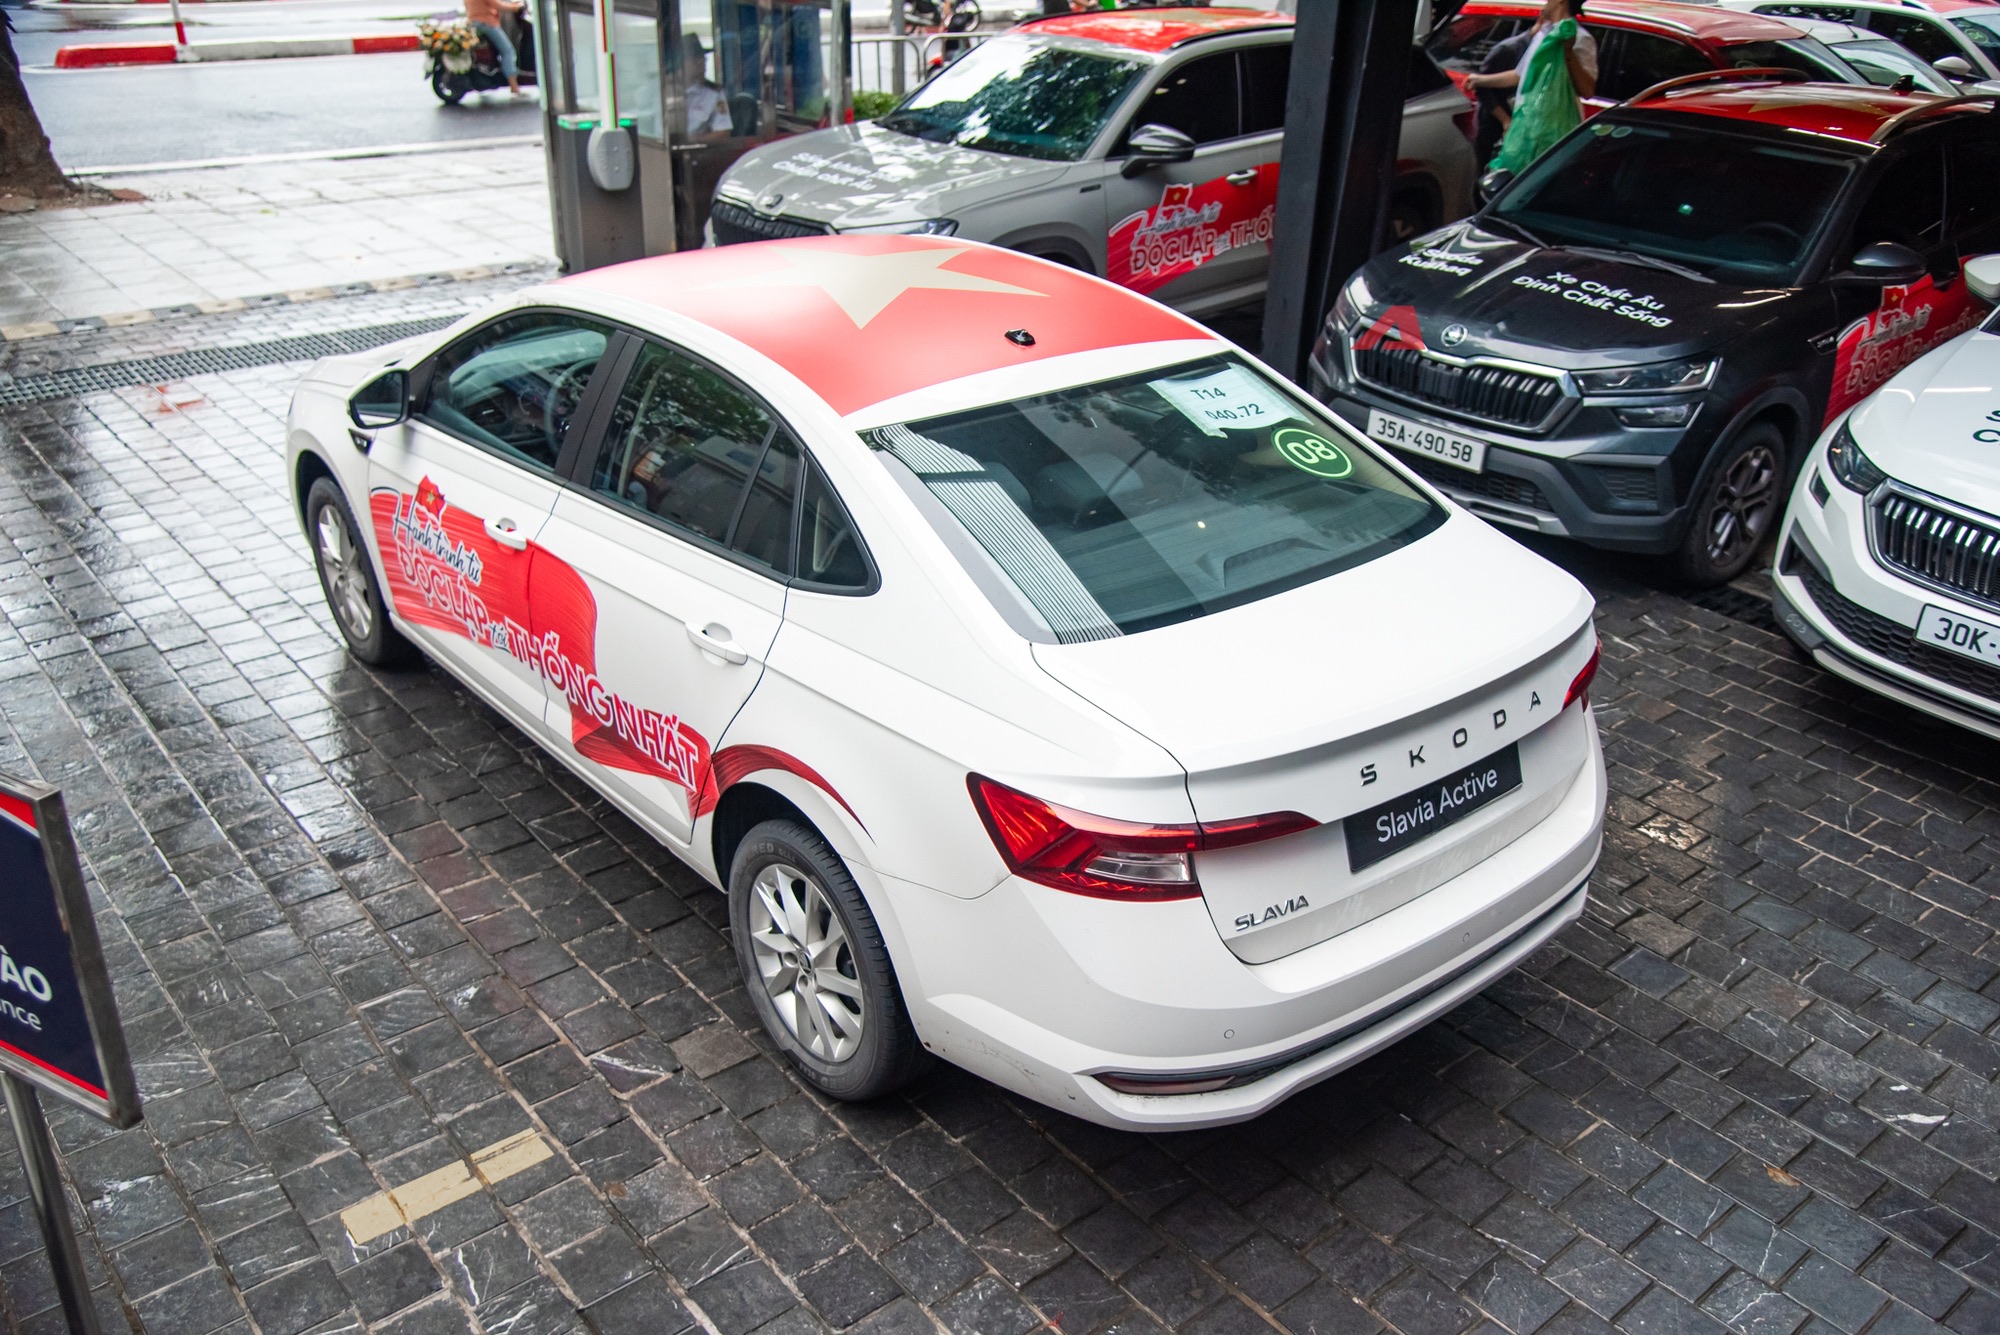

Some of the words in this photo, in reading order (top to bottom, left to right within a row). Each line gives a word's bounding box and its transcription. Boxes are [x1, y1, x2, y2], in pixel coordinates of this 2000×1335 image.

[1130, 233, 1181, 276] ĐỘC
[1179, 227, 1219, 266] LẬP
[1230, 205, 1276, 249] THỐ
[1511, 275, 1562, 294] Định
[1562, 289, 1616, 311] Chất
[1613, 304, 1674, 328] Sống
[1546, 271, 1579, 285] Xe
[1580, 280, 1634, 301] Chất
[1628, 295, 1666, 311] Âu
[1190, 387, 1226, 401] T14
[1286, 438, 1338, 465] 08
[1376, 417, 1473, 463] 35A-490.58
[1934, 616, 2000, 661] 30K-
[397, 541, 451, 607] ĐỘC
[444, 573, 490, 643] LẬP
[504, 615, 614, 727] THỐNG
[612, 692, 699, 793] NHẤT
[1360, 690, 1542, 787] SKODA
[1375, 799, 1435, 843] Slavia
[1438, 768, 1498, 814] Active
[1235, 894, 1310, 932] SLAVIA
[0, 943, 53, 1002] ÀO
[0, 998, 43, 1031] nce
